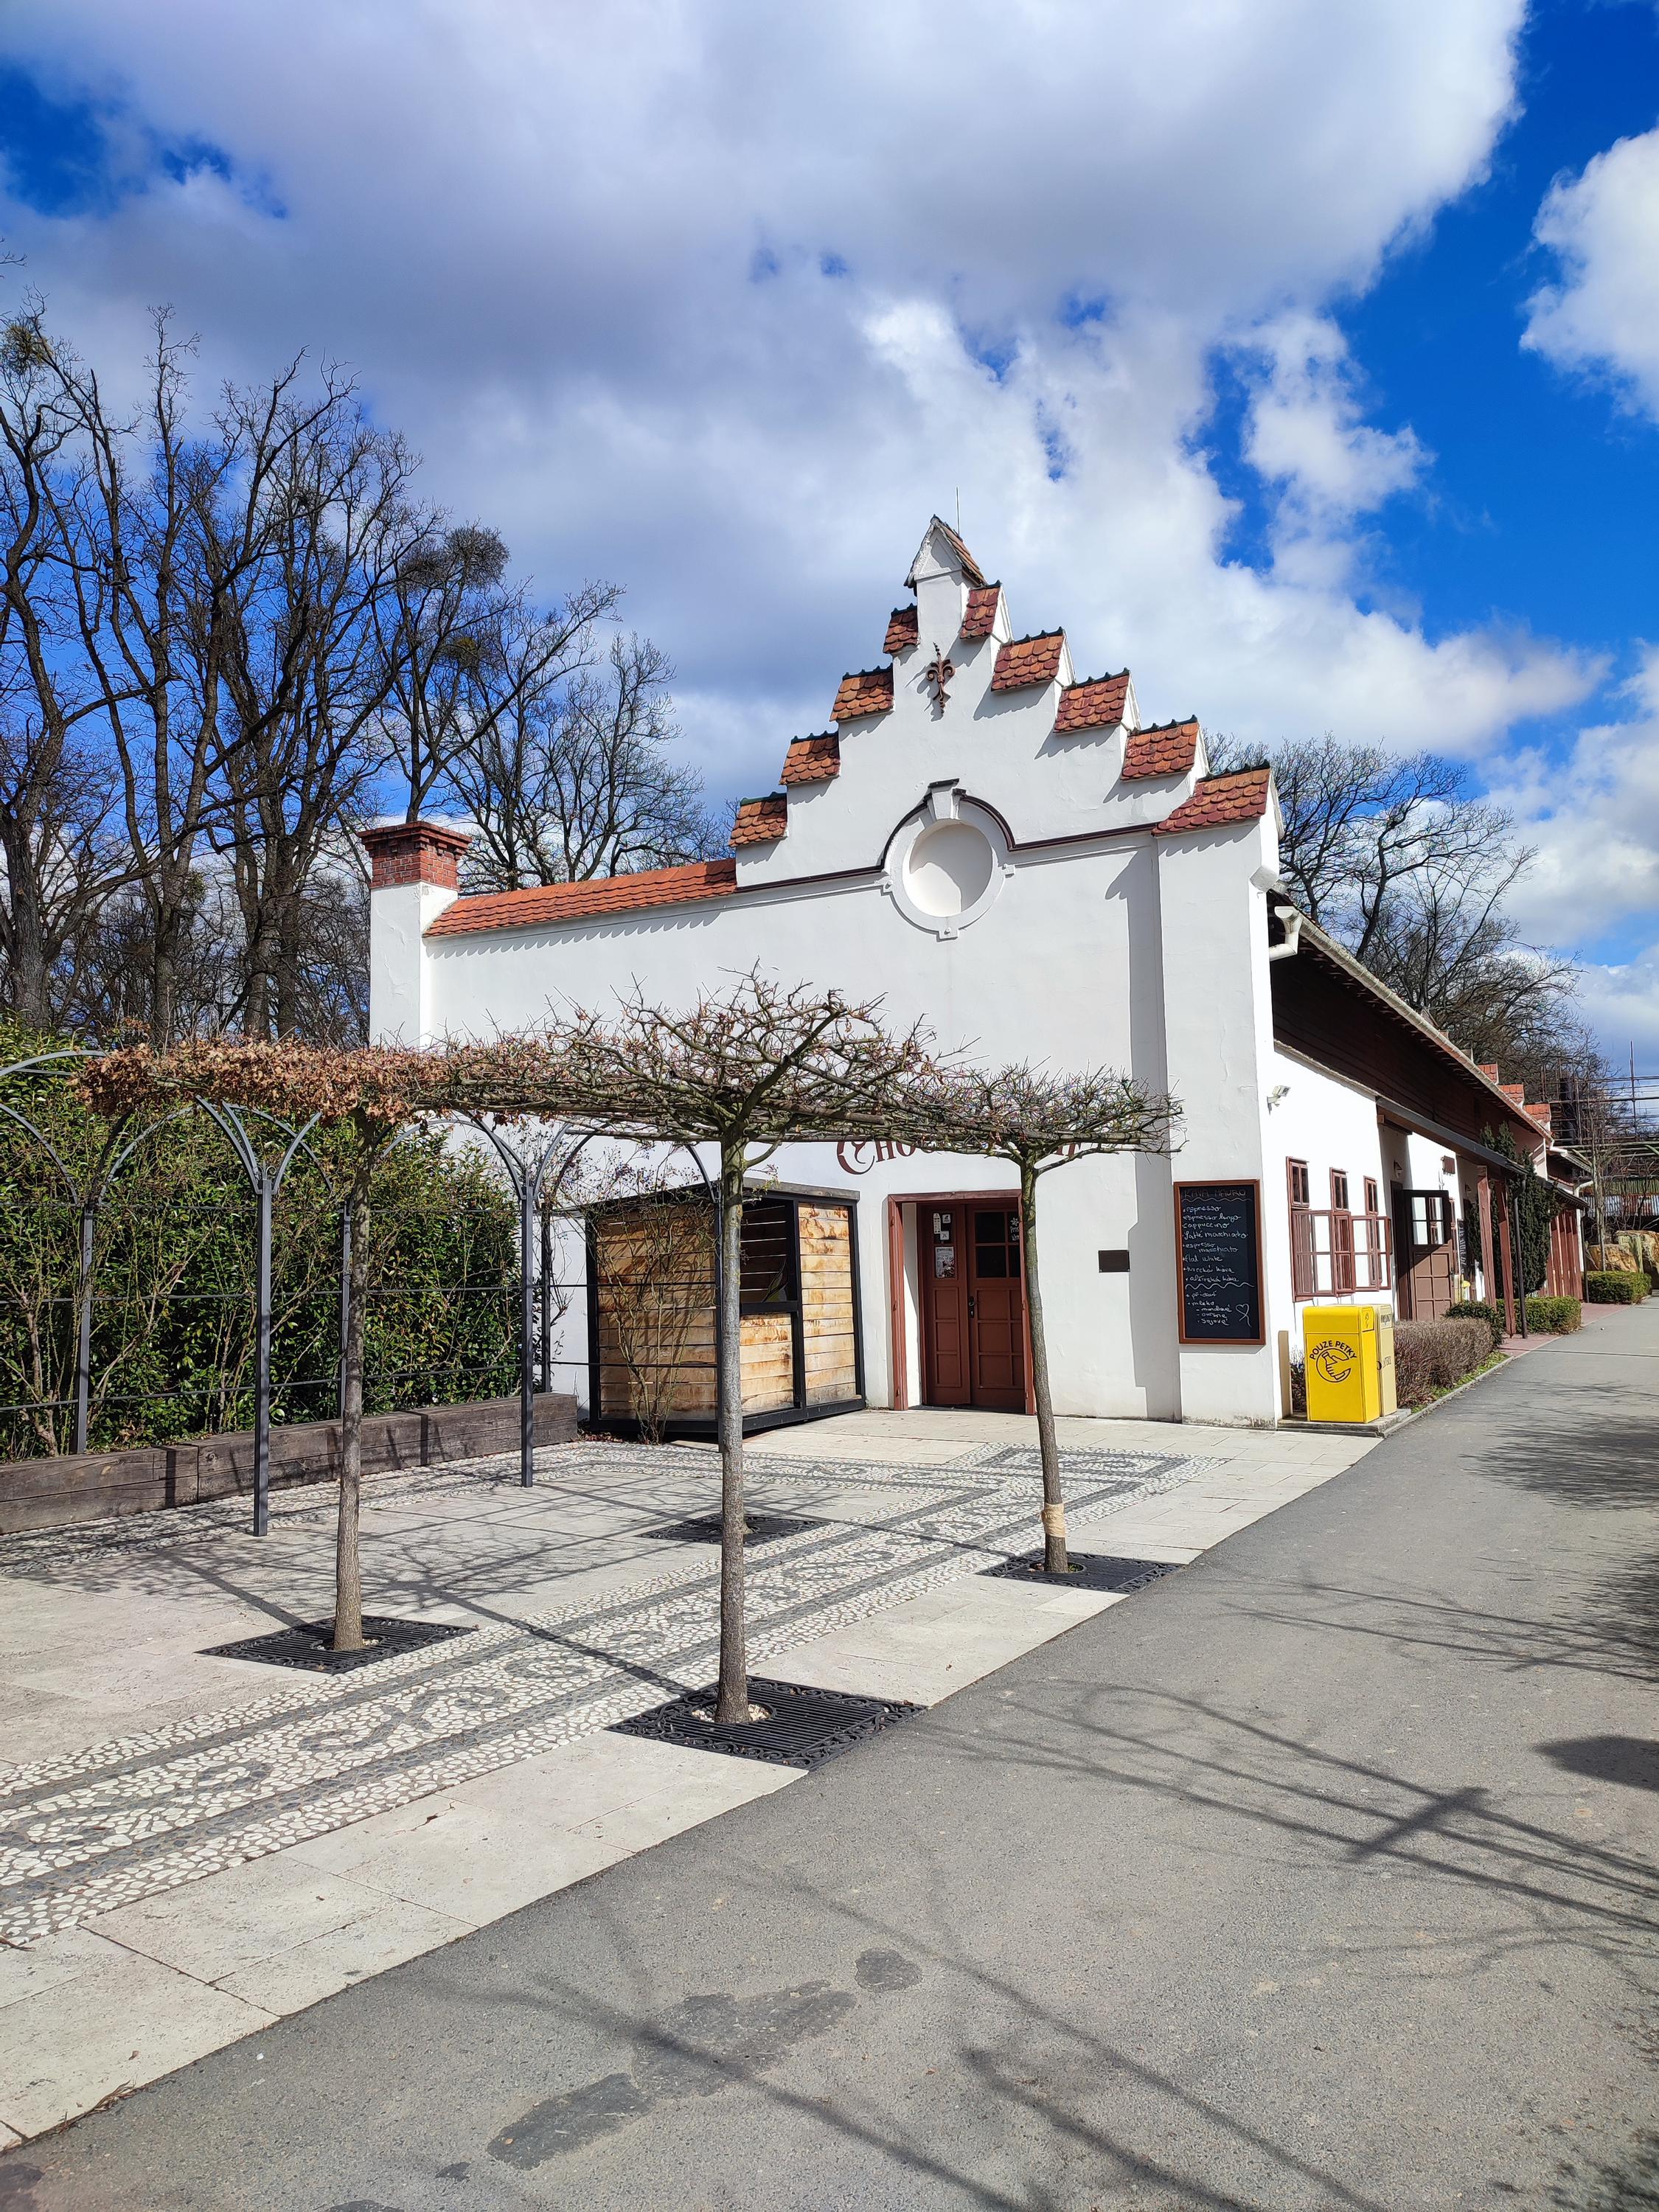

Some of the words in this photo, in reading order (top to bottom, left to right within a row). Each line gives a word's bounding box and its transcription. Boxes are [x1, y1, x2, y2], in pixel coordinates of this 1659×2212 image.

[1186, 1205, 1221, 1215] espresso
[1184, 1214, 1217, 1222] espresso
[1218, 1212, 1242, 1223] lungo
[1185, 1241, 1216, 1250] espresso
[1198, 1245, 1239, 1253] macchiato
[1184, 1253, 1199, 1263] flat
[1202, 1255, 1222, 1263] white
[1186, 1265, 1214, 1273] turecká
[1309, 1340, 1333, 1360] POUZE
[1335, 1340, 1357, 1360] PETKY
